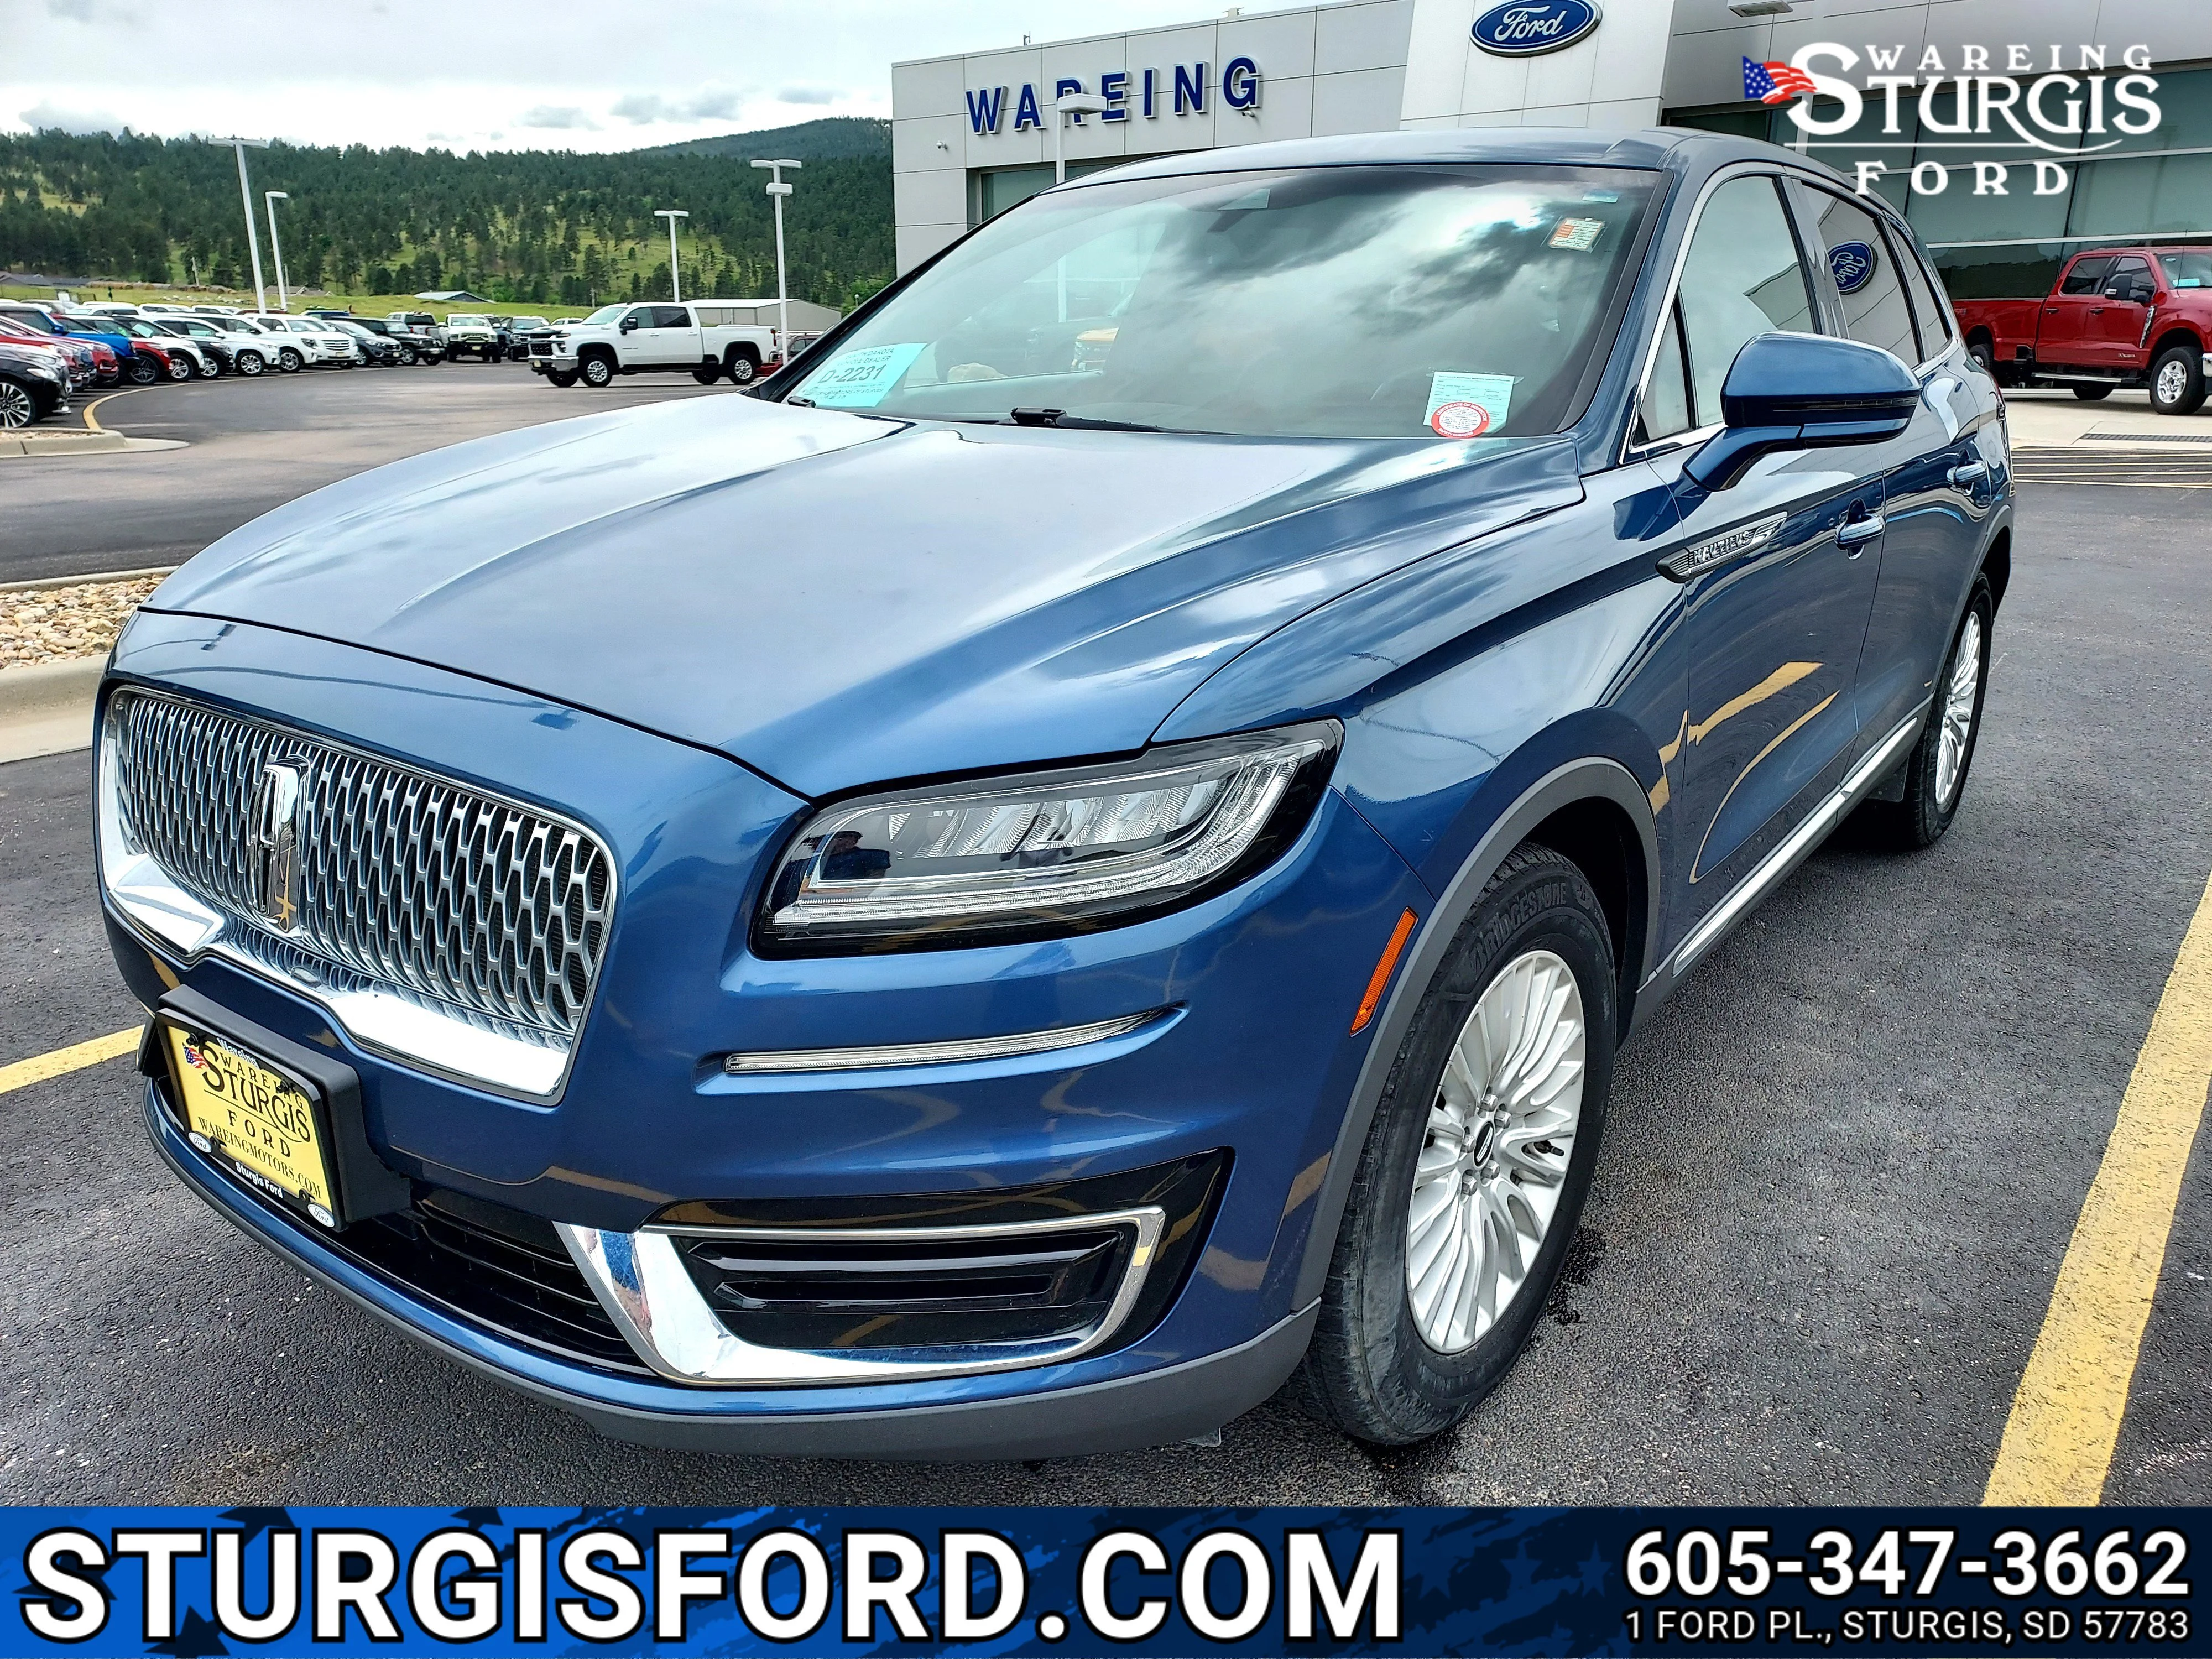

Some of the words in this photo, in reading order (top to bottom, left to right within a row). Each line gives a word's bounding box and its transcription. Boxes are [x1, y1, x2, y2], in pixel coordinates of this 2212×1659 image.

[1494, 4, 1568, 41] Ford
[965, 55, 1261, 135] WAREING
[817, 364, 886, 384] D-2231
[199, 1041, 311, 1142] STURGIS
[193, 1135, 207, 1150] Ford
[227, 1109, 290, 1157] FORD
[198, 1116, 322, 1199] WAREINGMOTORS.COM
[236, 1161, 264, 1187] Sturgis
[264, 1178, 283, 1198] Ford
[314, 1208, 329, 1224] Ford
